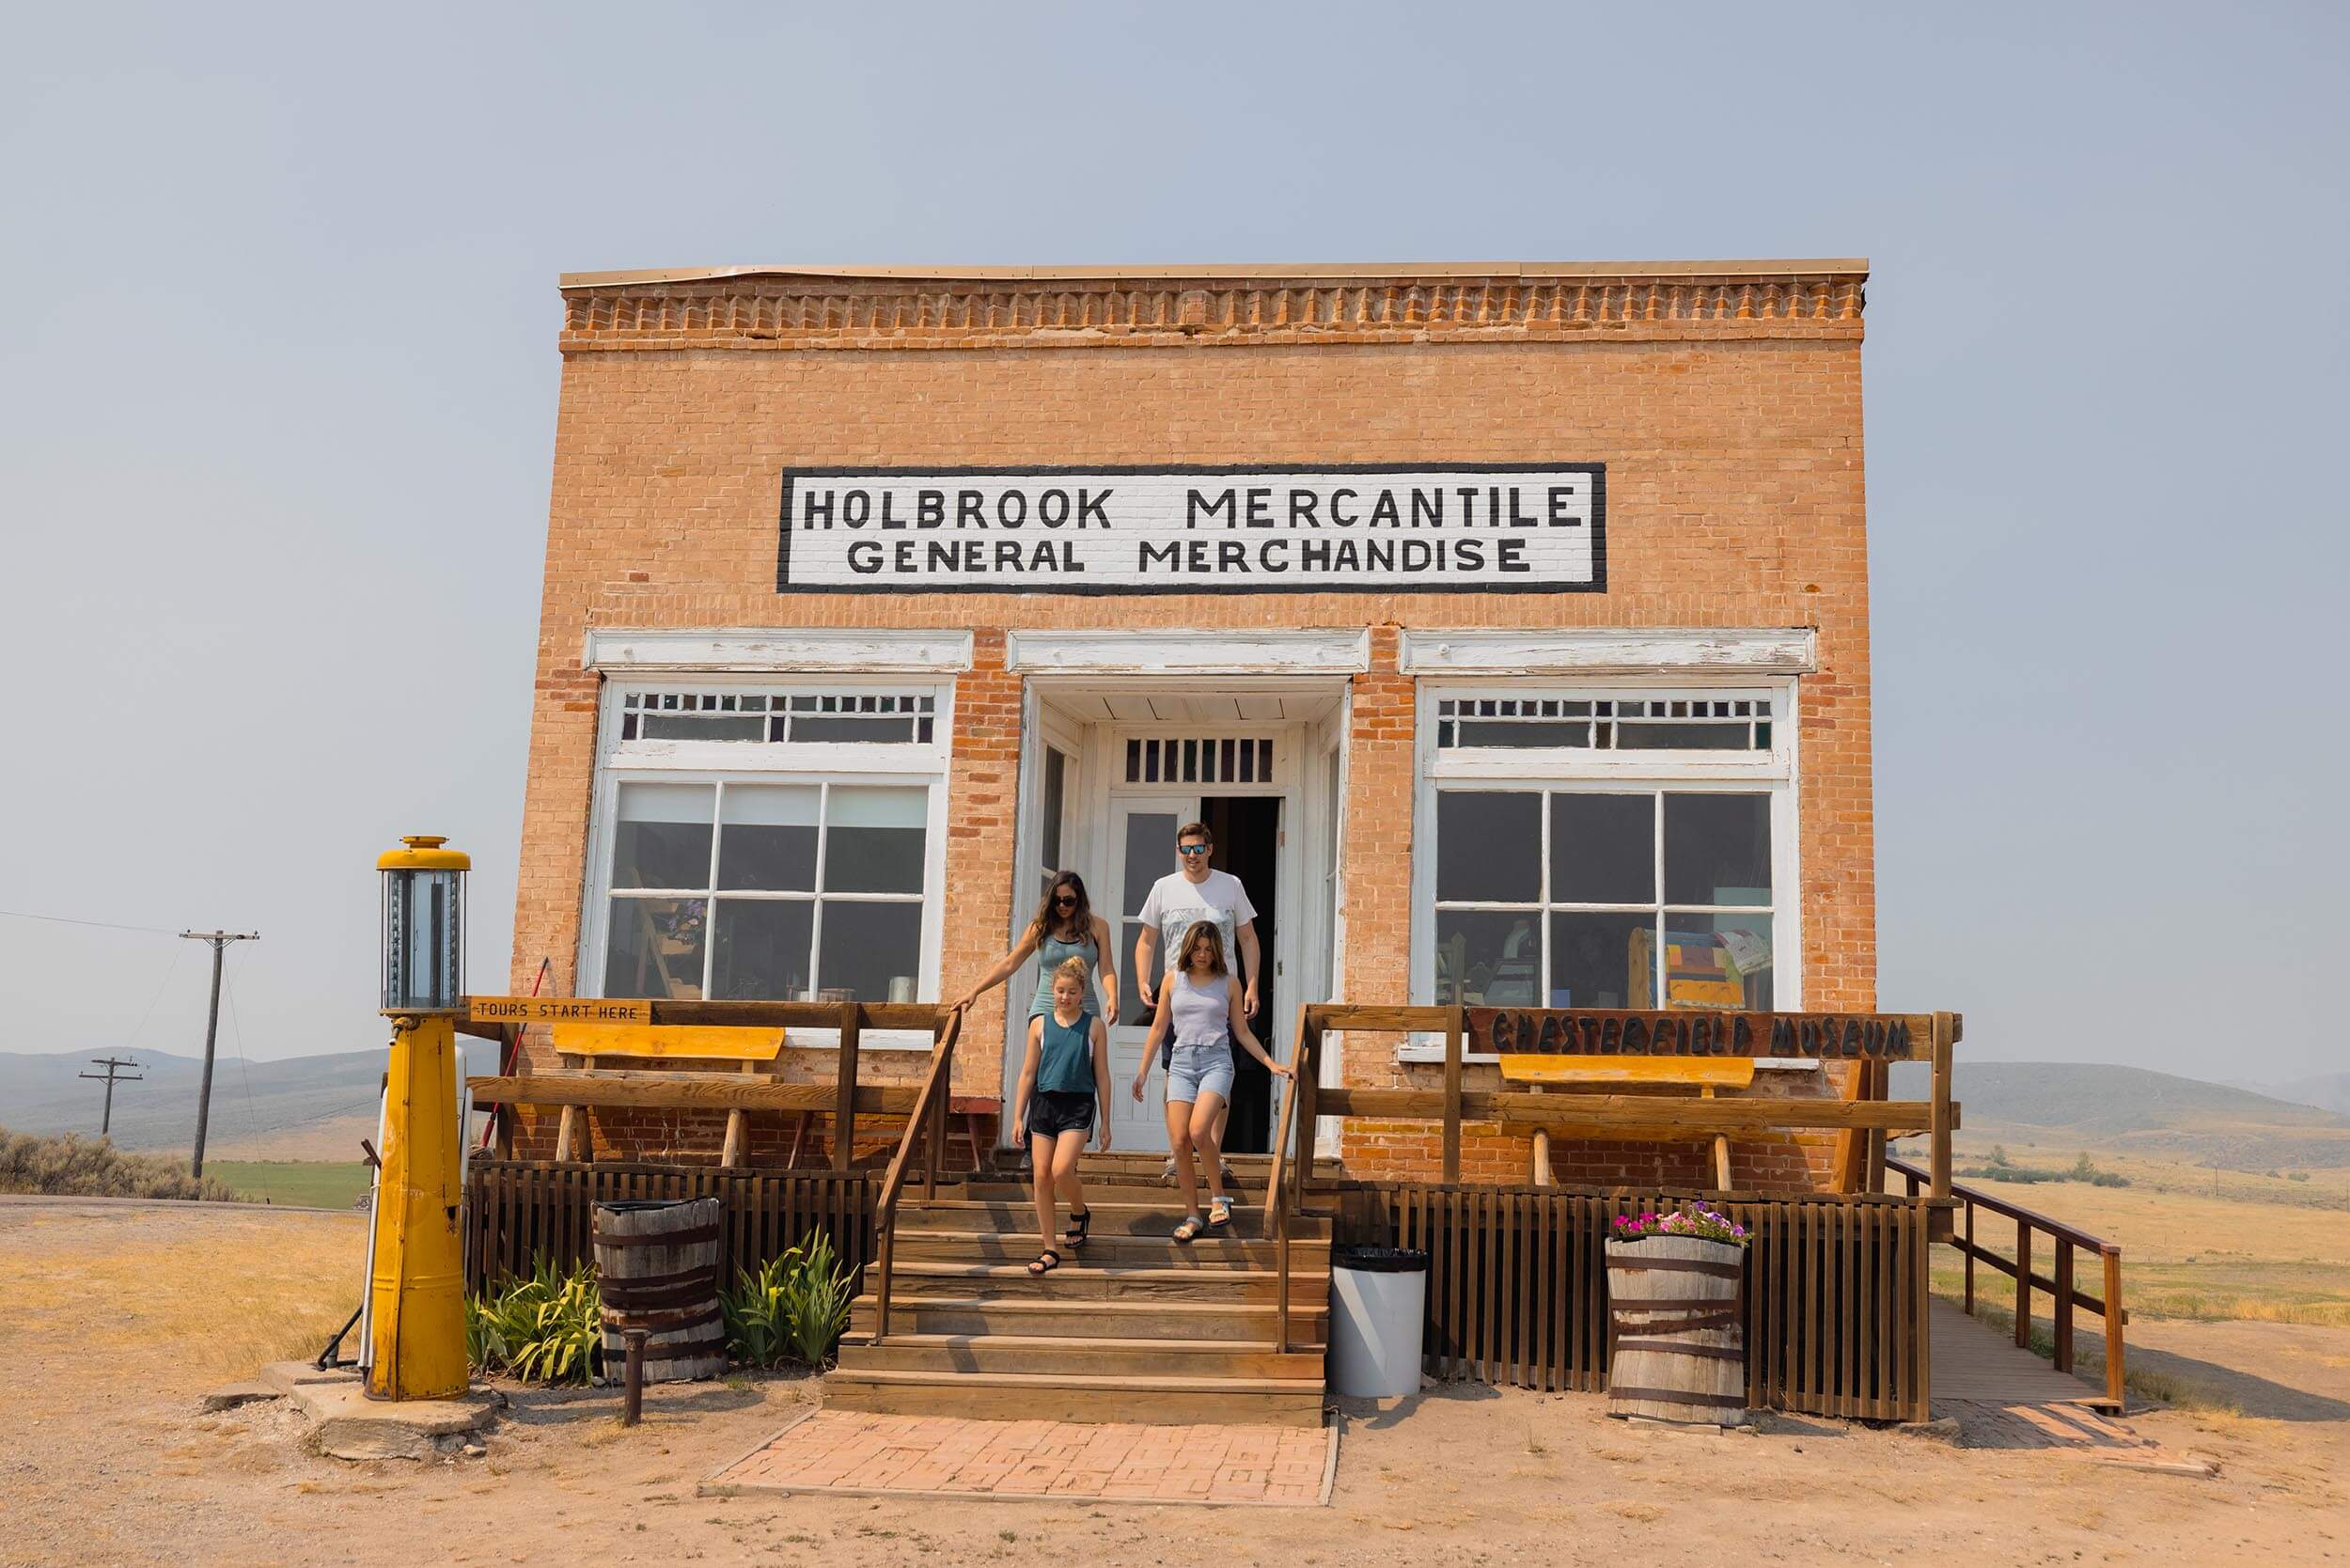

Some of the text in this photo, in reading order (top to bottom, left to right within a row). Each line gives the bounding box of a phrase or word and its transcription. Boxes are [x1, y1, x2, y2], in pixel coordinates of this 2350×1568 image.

[804, 486, 1582, 530] HOLBROOK MERCANTILE
[847, 538, 1530, 574] GENERAL MERCHANDISE
[478, 1002, 637, 1020] TOURS START HERE
[1492, 1012, 1911, 1058] CHESTERFIELD MUSEUM
